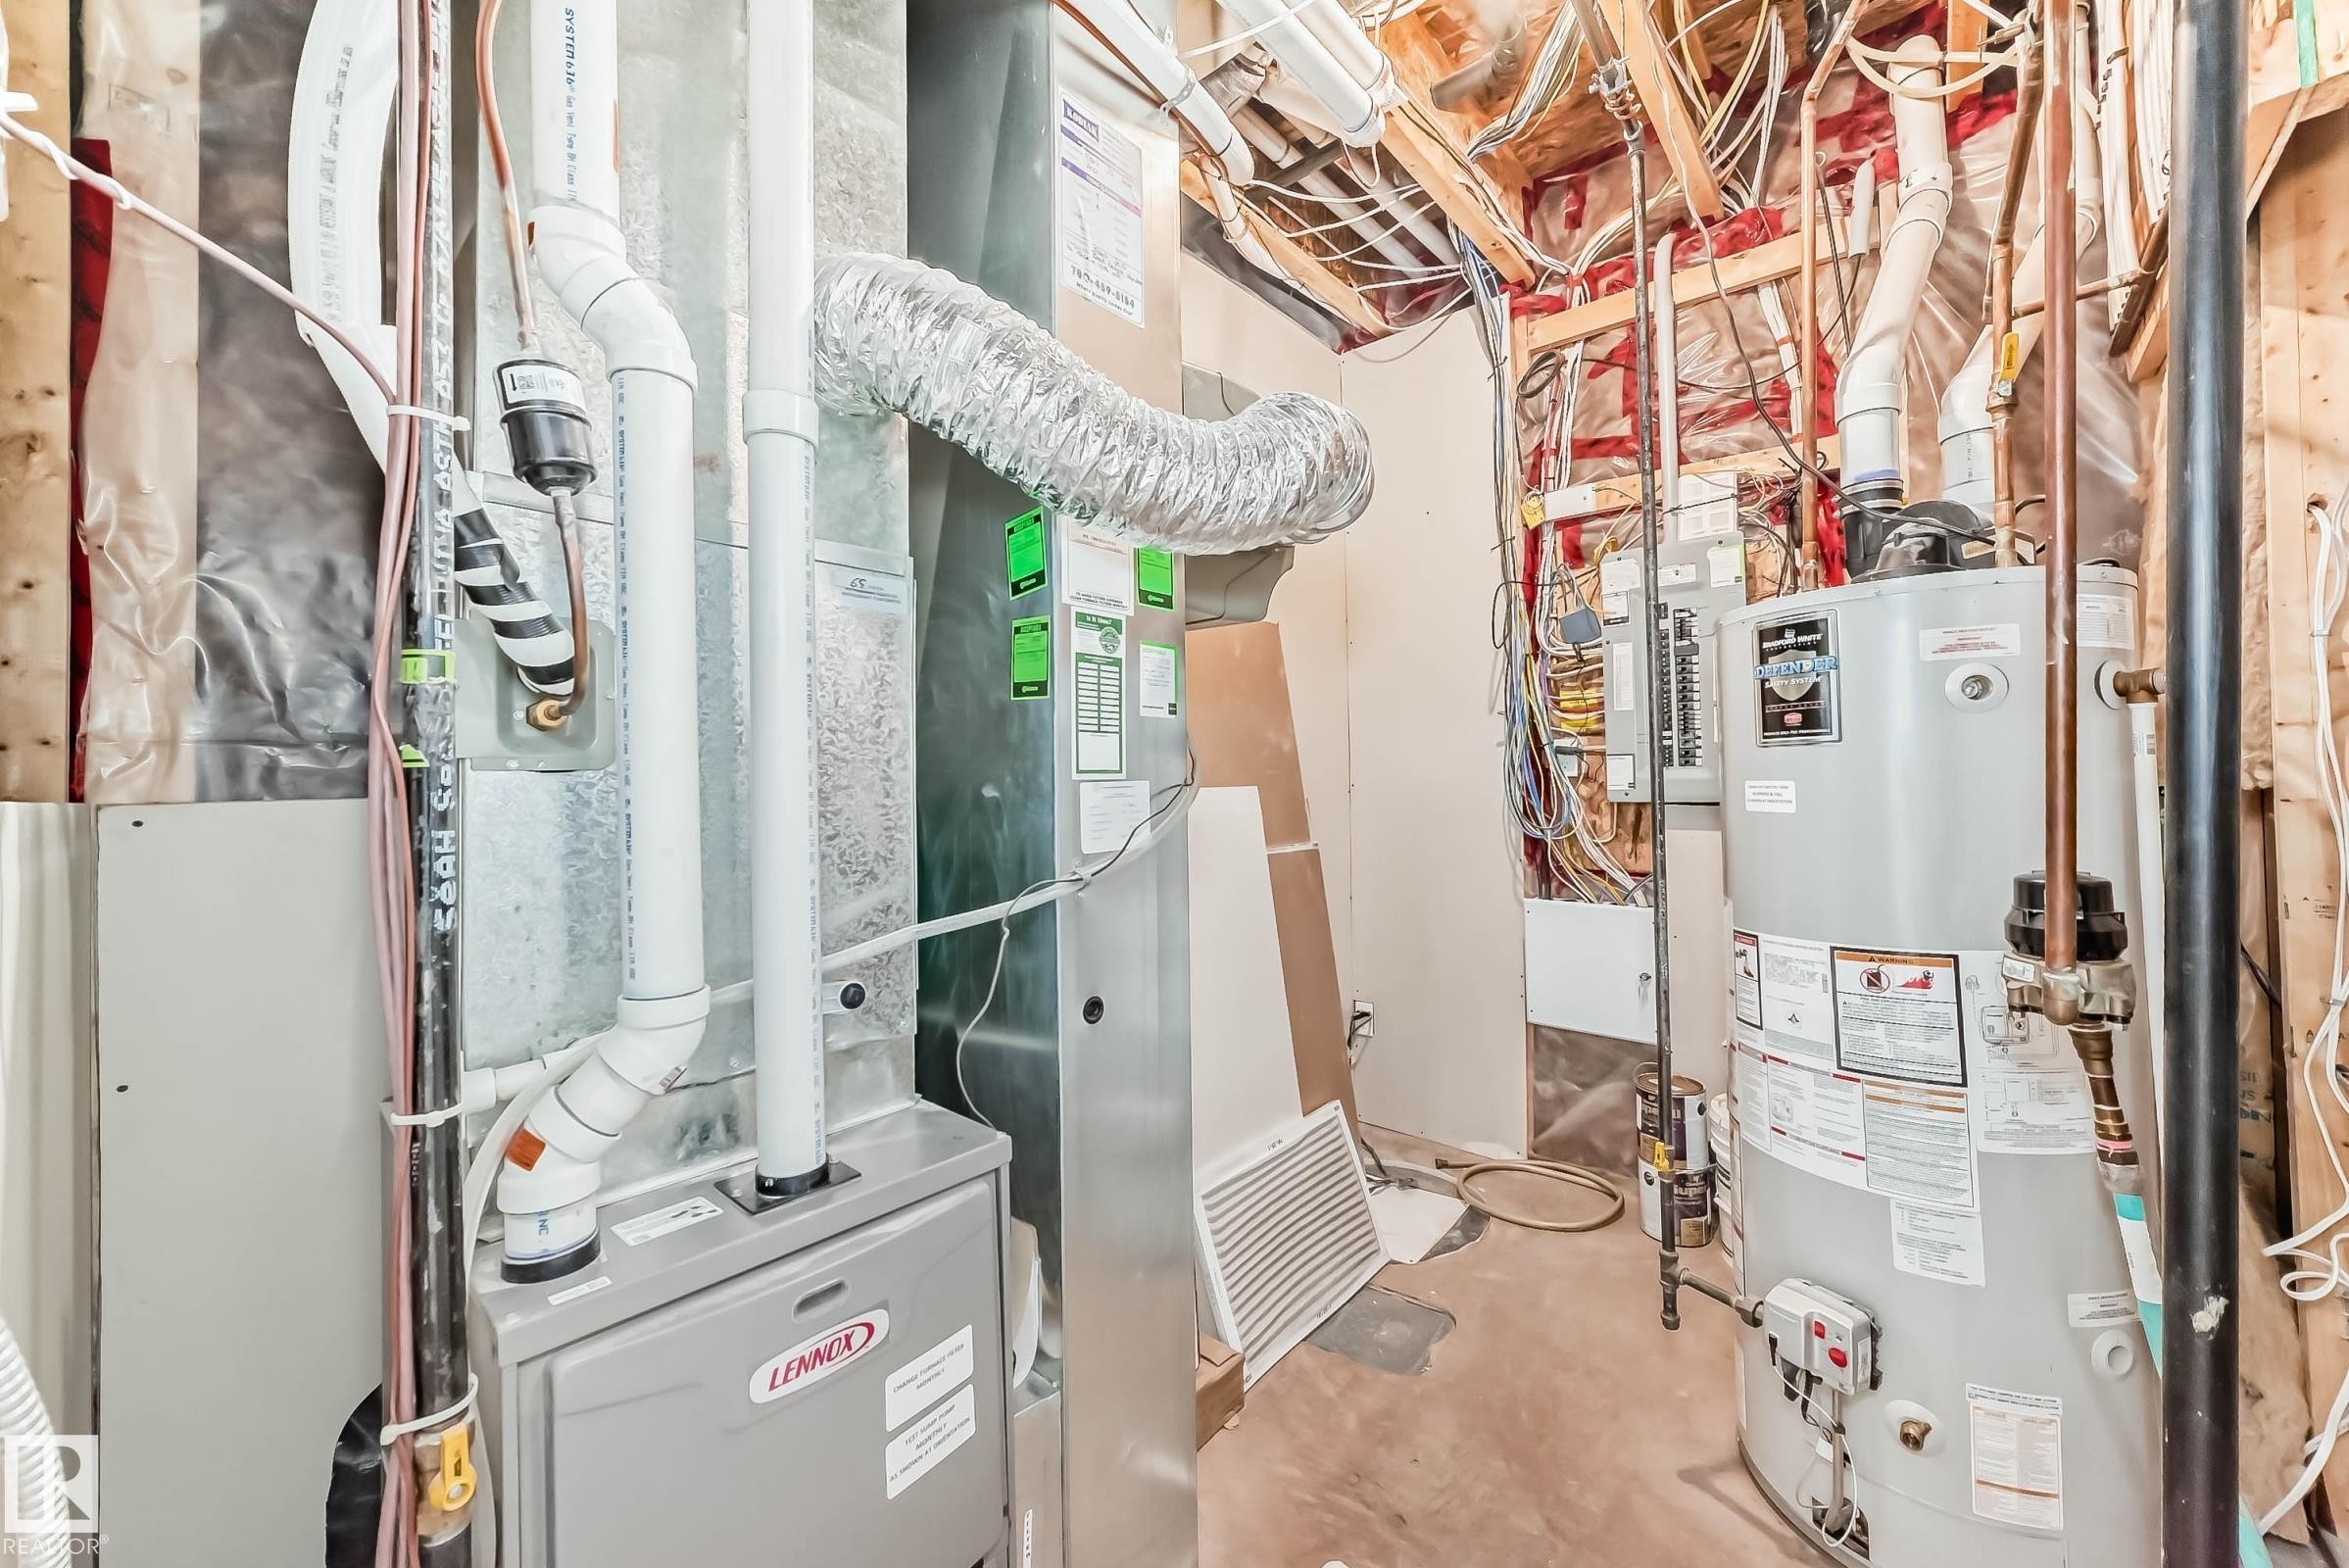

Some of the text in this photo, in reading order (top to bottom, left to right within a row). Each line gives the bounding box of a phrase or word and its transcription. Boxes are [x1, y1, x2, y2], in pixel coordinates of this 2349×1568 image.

[1762, 632, 1824, 649] BRADFORD WHITE
[1755, 656, 1837, 679] DEFENDER
[1764, 675, 1823, 689] SAFETY SYSTEM
[1878, 956, 1915, 966] WARNING
[767, 1329, 856, 1393] LENNOX
[893, 1343, 965, 1395] CHANGE FURNACE FILTER
[916, 1368, 946, 1391] MONTHLY
[905, 1403, 955, 1446] TEST SUMP PUMP
[915, 1421, 948, 1450] MONTHLY
[889, 1472, 899, 1483] AS
[899, 1453, 923, 1477] SHOWN
[933, 1416, 971, 1450] ORIENTATION
